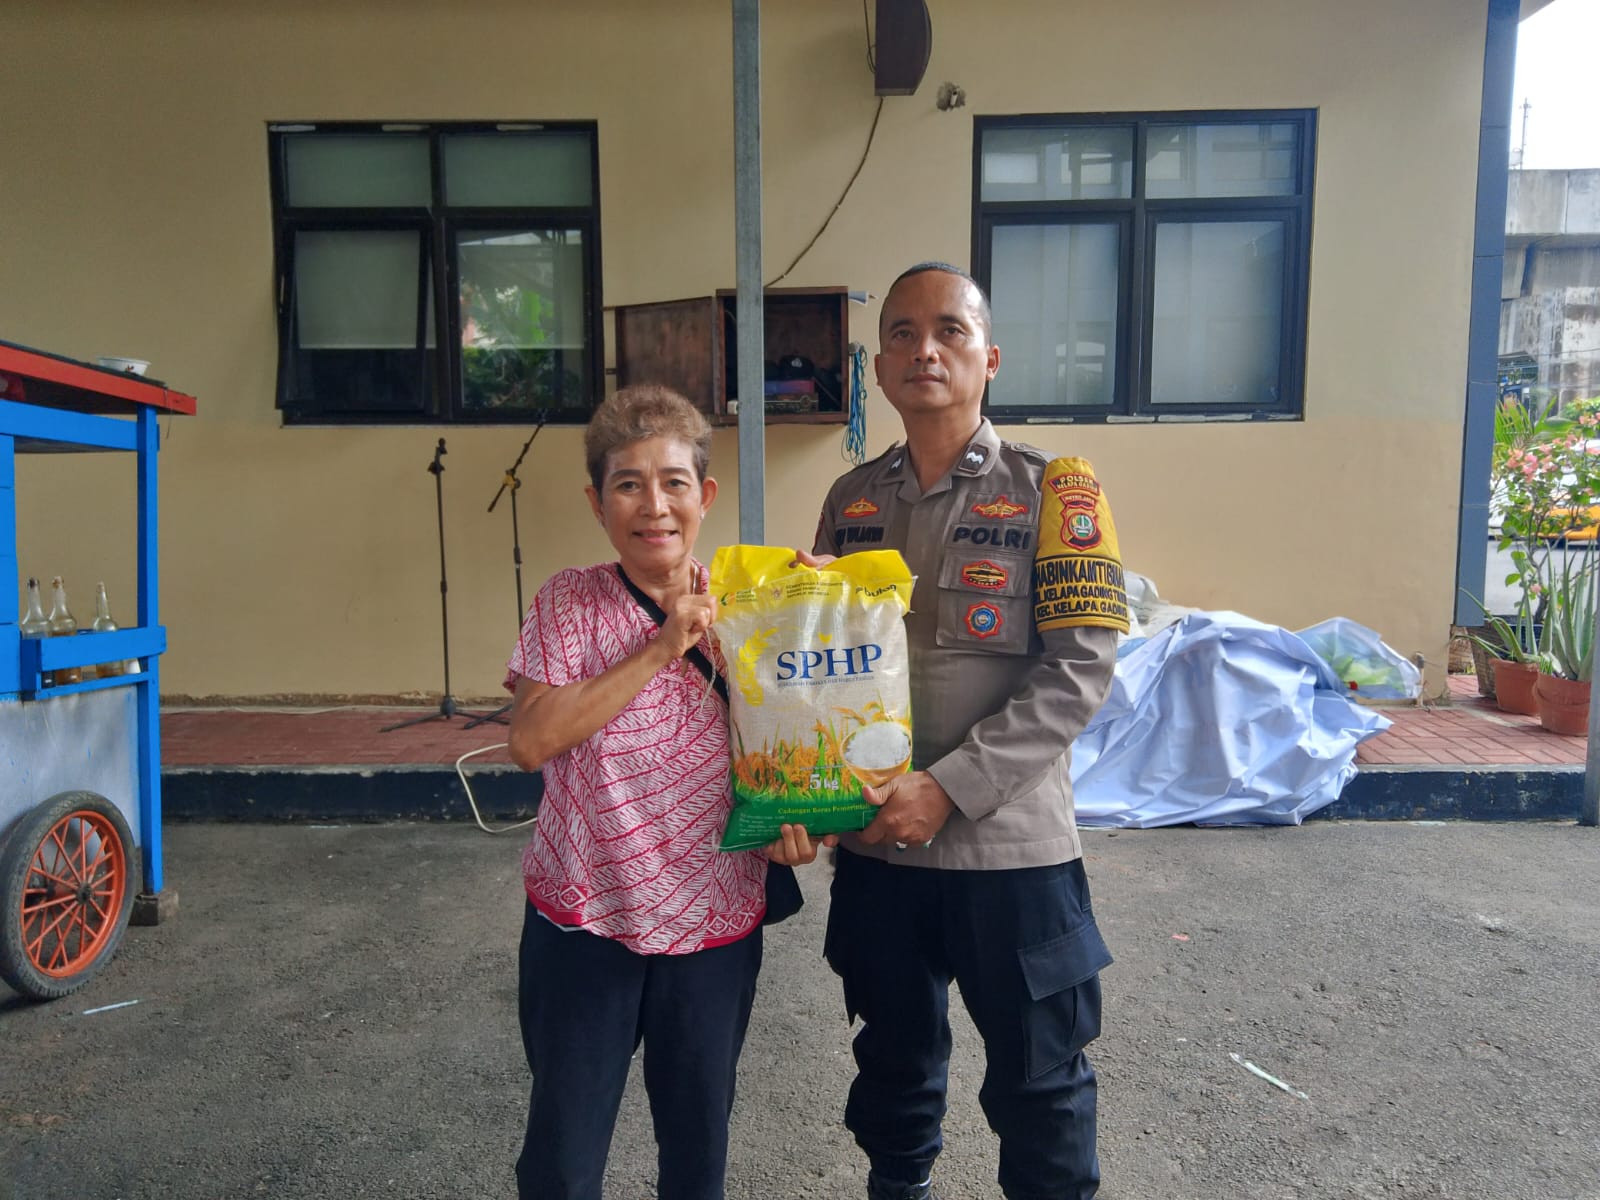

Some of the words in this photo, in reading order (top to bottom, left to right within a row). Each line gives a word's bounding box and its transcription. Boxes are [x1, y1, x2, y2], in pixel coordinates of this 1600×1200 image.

[953, 526, 1032, 550] POLRI
[1054, 600, 1098, 614] KELAPA
[776, 643, 882, 681] SPHP
[809, 773, 822, 790] 5
[823, 777, 840, 791] kg
